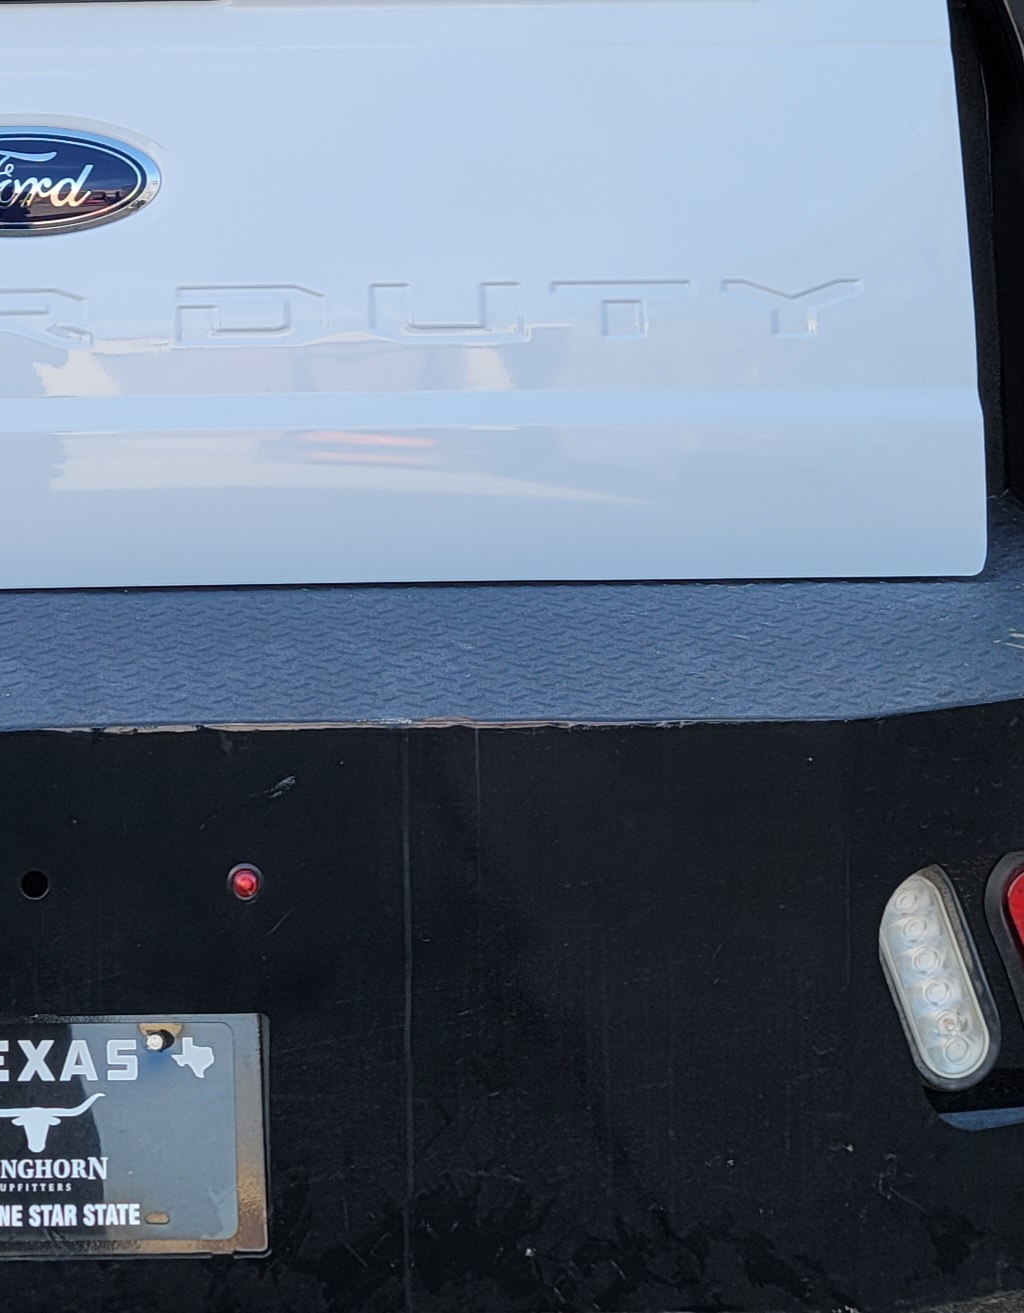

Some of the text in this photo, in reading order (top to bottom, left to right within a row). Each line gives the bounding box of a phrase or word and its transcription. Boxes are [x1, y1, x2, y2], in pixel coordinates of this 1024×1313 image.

[175, 276, 864, 348] DUTY
[0, 1182, 73, 1193] UPFITTERS
[28, 1204, 78, 1227] STAR
[82, 1203, 141, 1227] STATE
